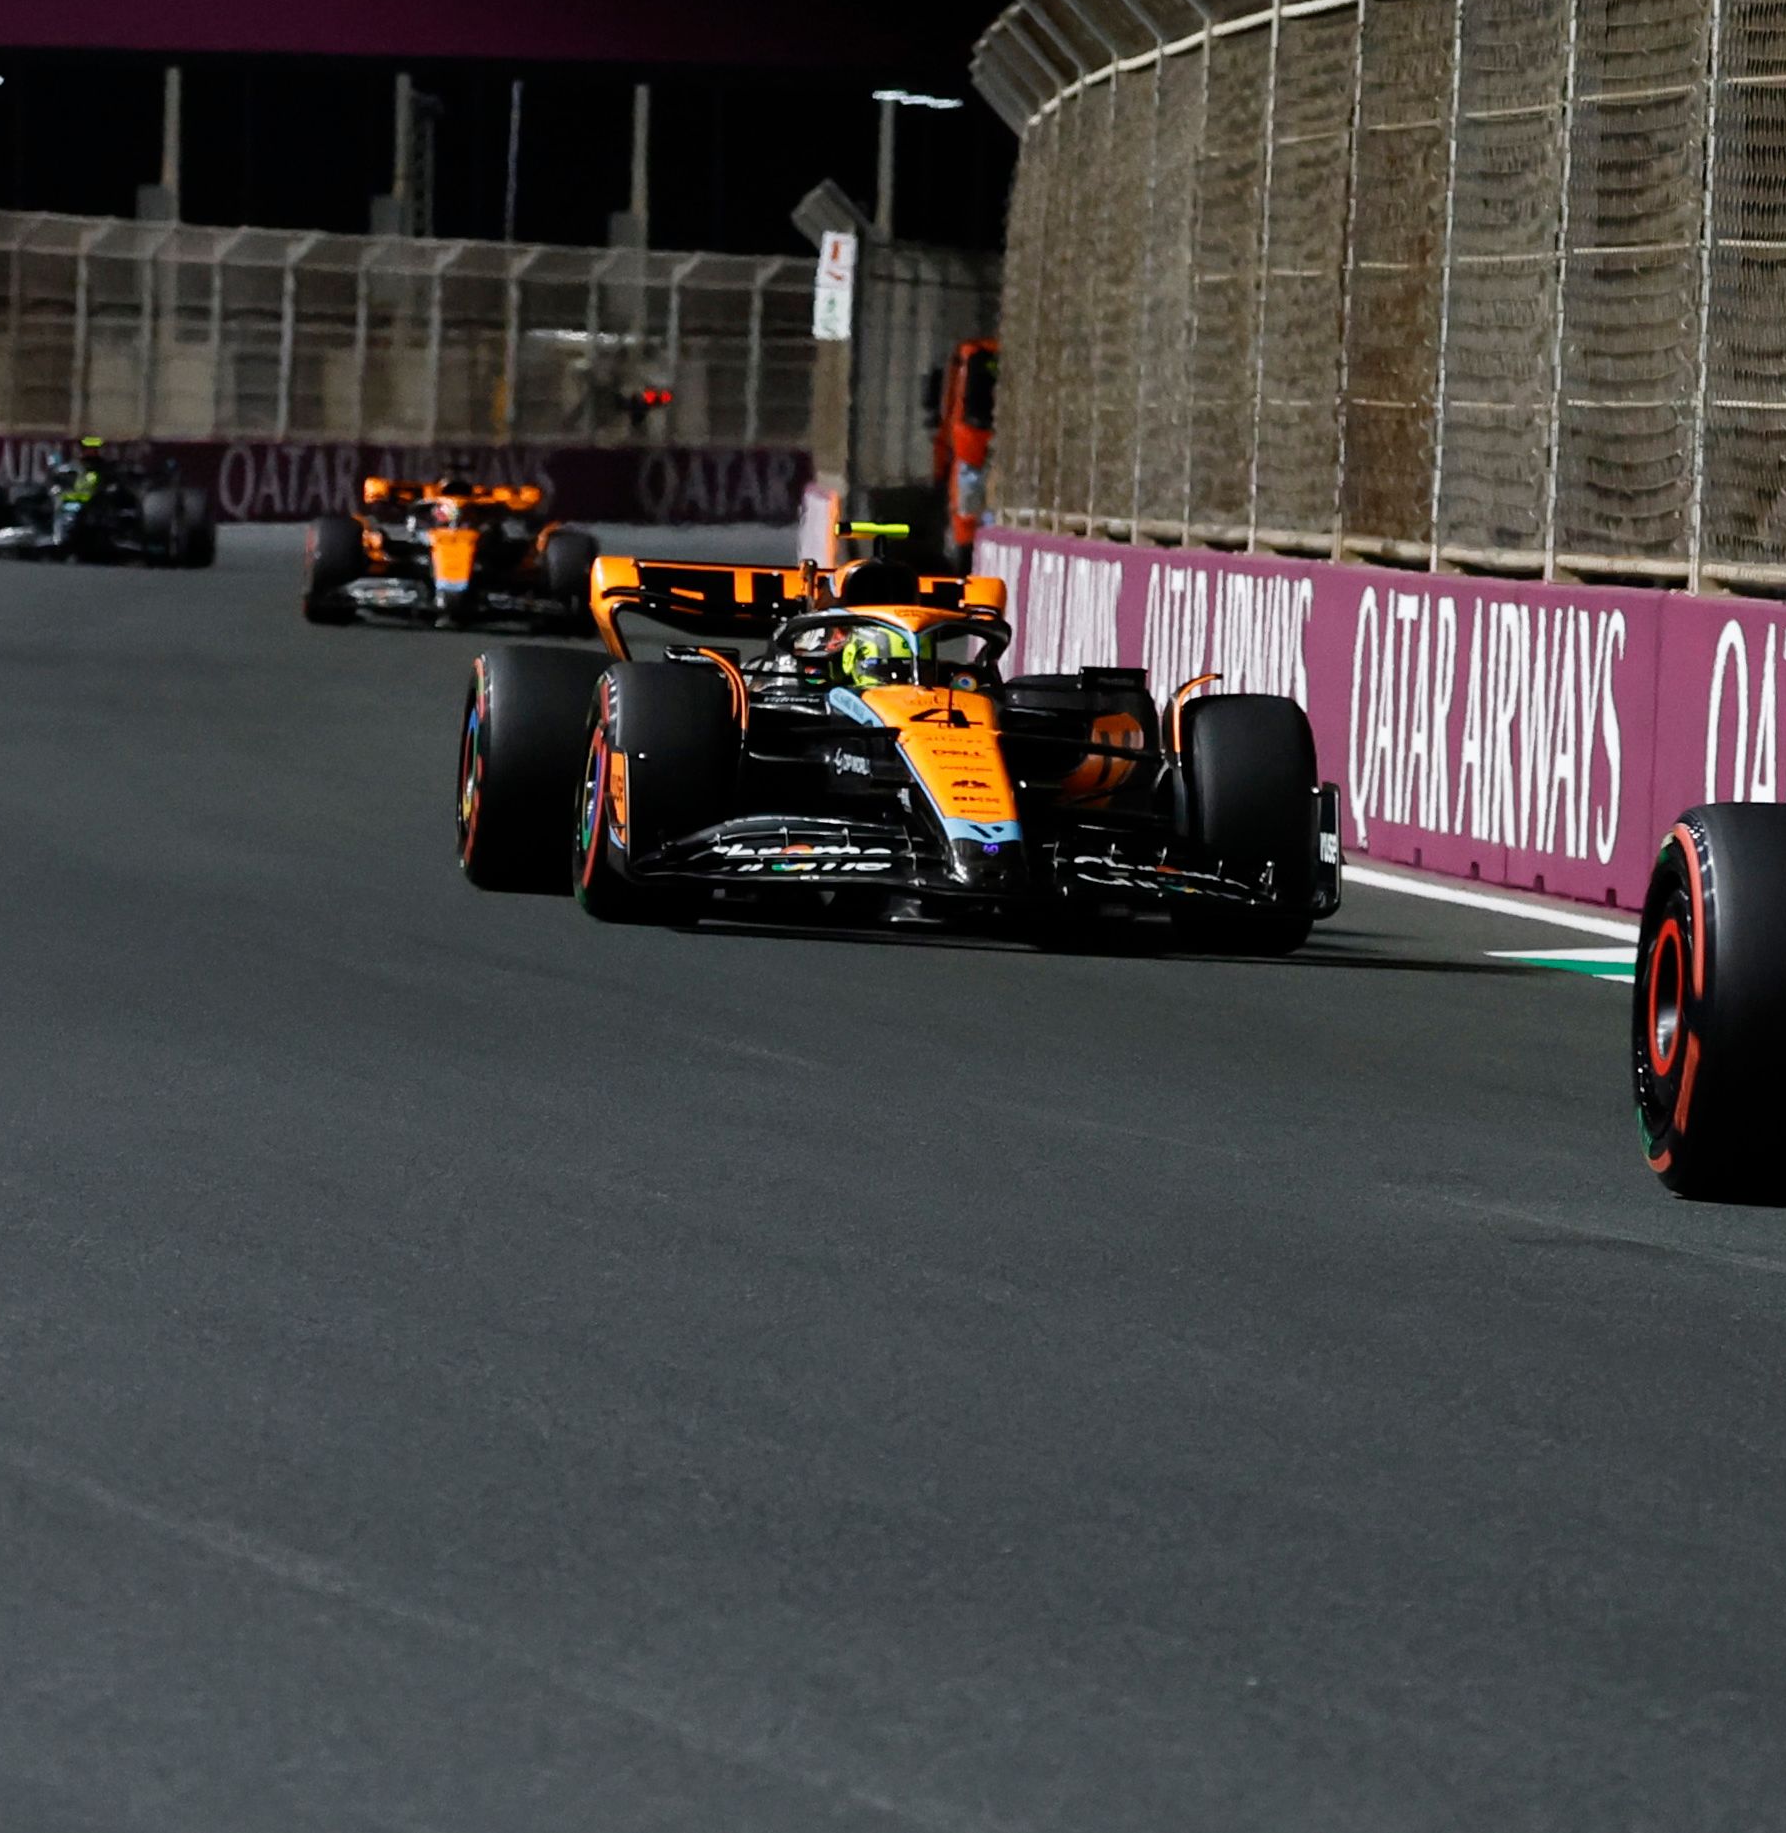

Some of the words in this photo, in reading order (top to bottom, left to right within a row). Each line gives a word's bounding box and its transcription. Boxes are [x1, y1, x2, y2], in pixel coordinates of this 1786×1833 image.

[217, 442, 363, 521] QATAR
[1347, 584, 1458, 849] QATAR
[1459, 596, 1626, 865] AIRWAYS
